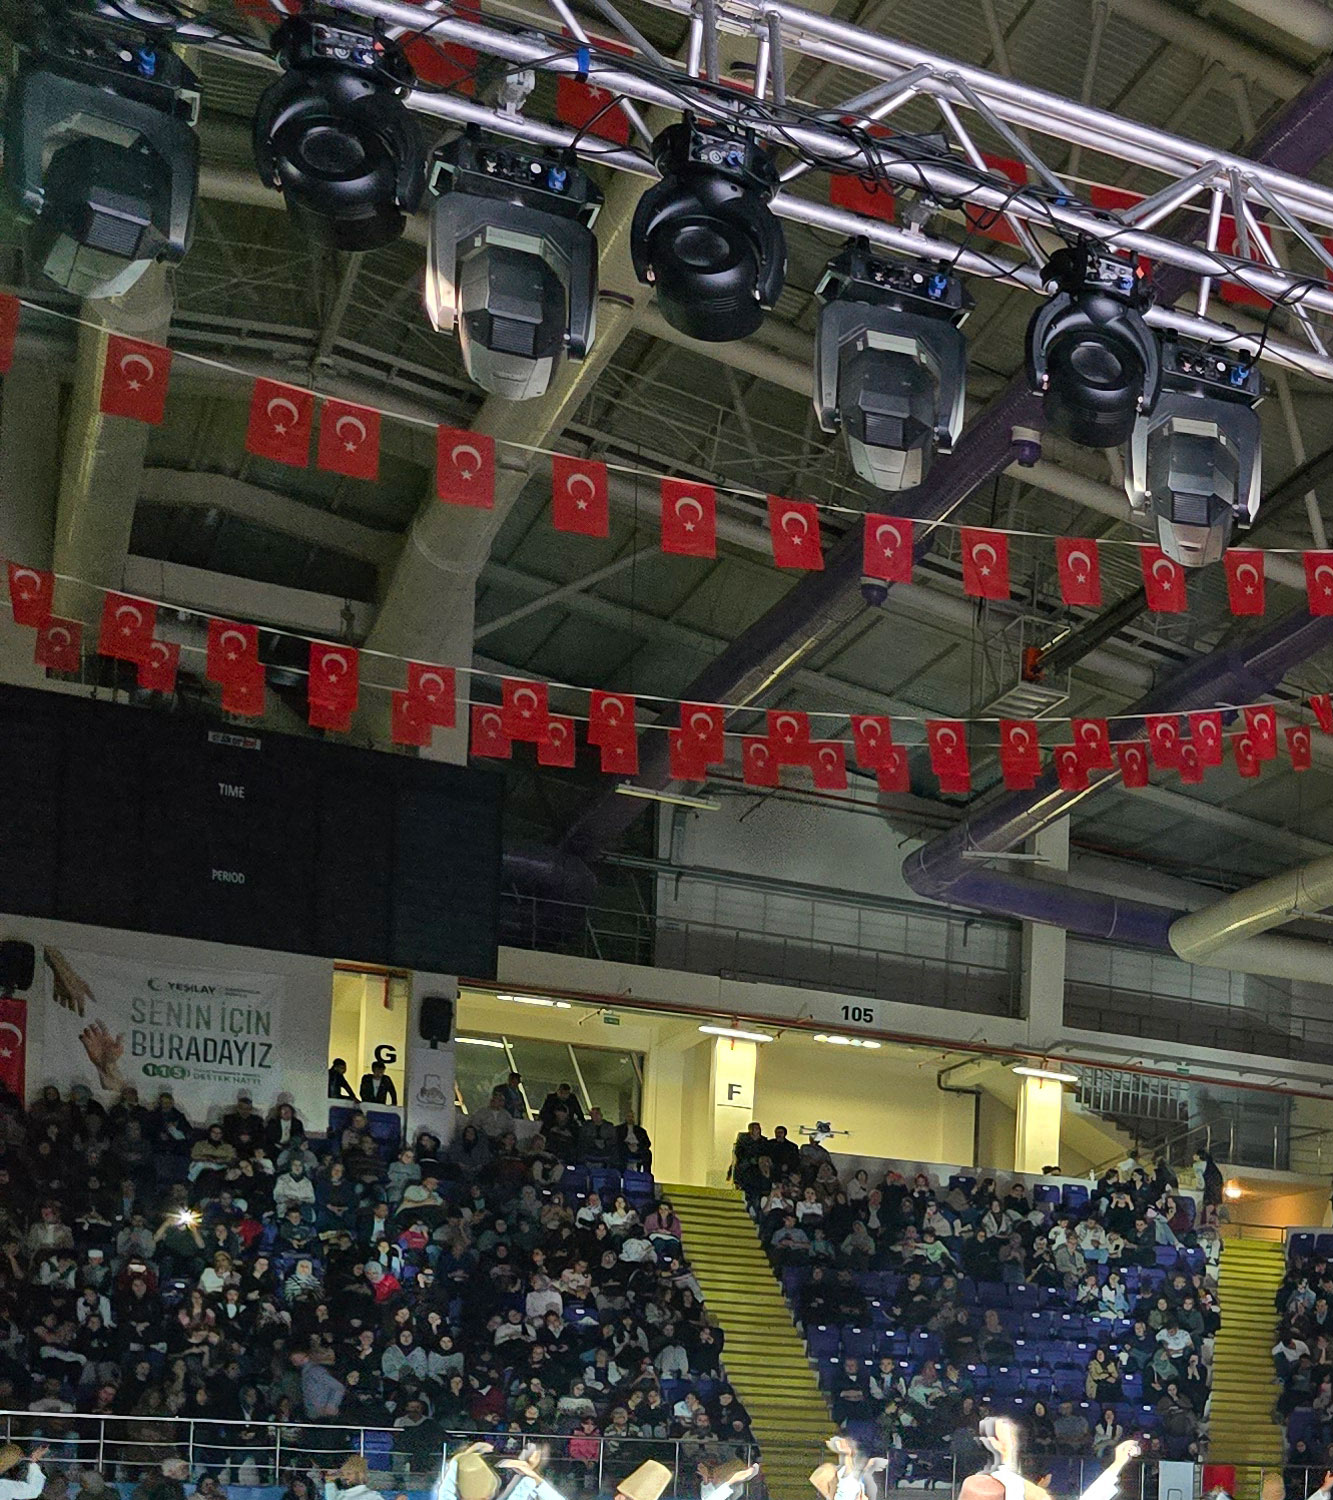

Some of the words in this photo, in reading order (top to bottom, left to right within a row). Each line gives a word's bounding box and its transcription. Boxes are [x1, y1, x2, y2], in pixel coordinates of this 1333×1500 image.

[217, 782, 246, 799] TIME
[211, 868, 246, 884] PERIOD
[130, 997, 212, 1031] SENİN
[220, 1001, 271, 1038] İÇİN
[840, 1005, 874, 1024] 105
[131, 1029, 274, 1069] BURADAYIZ
[374, 1044, 397, 1064] G
[727, 1083, 742, 1101] F
